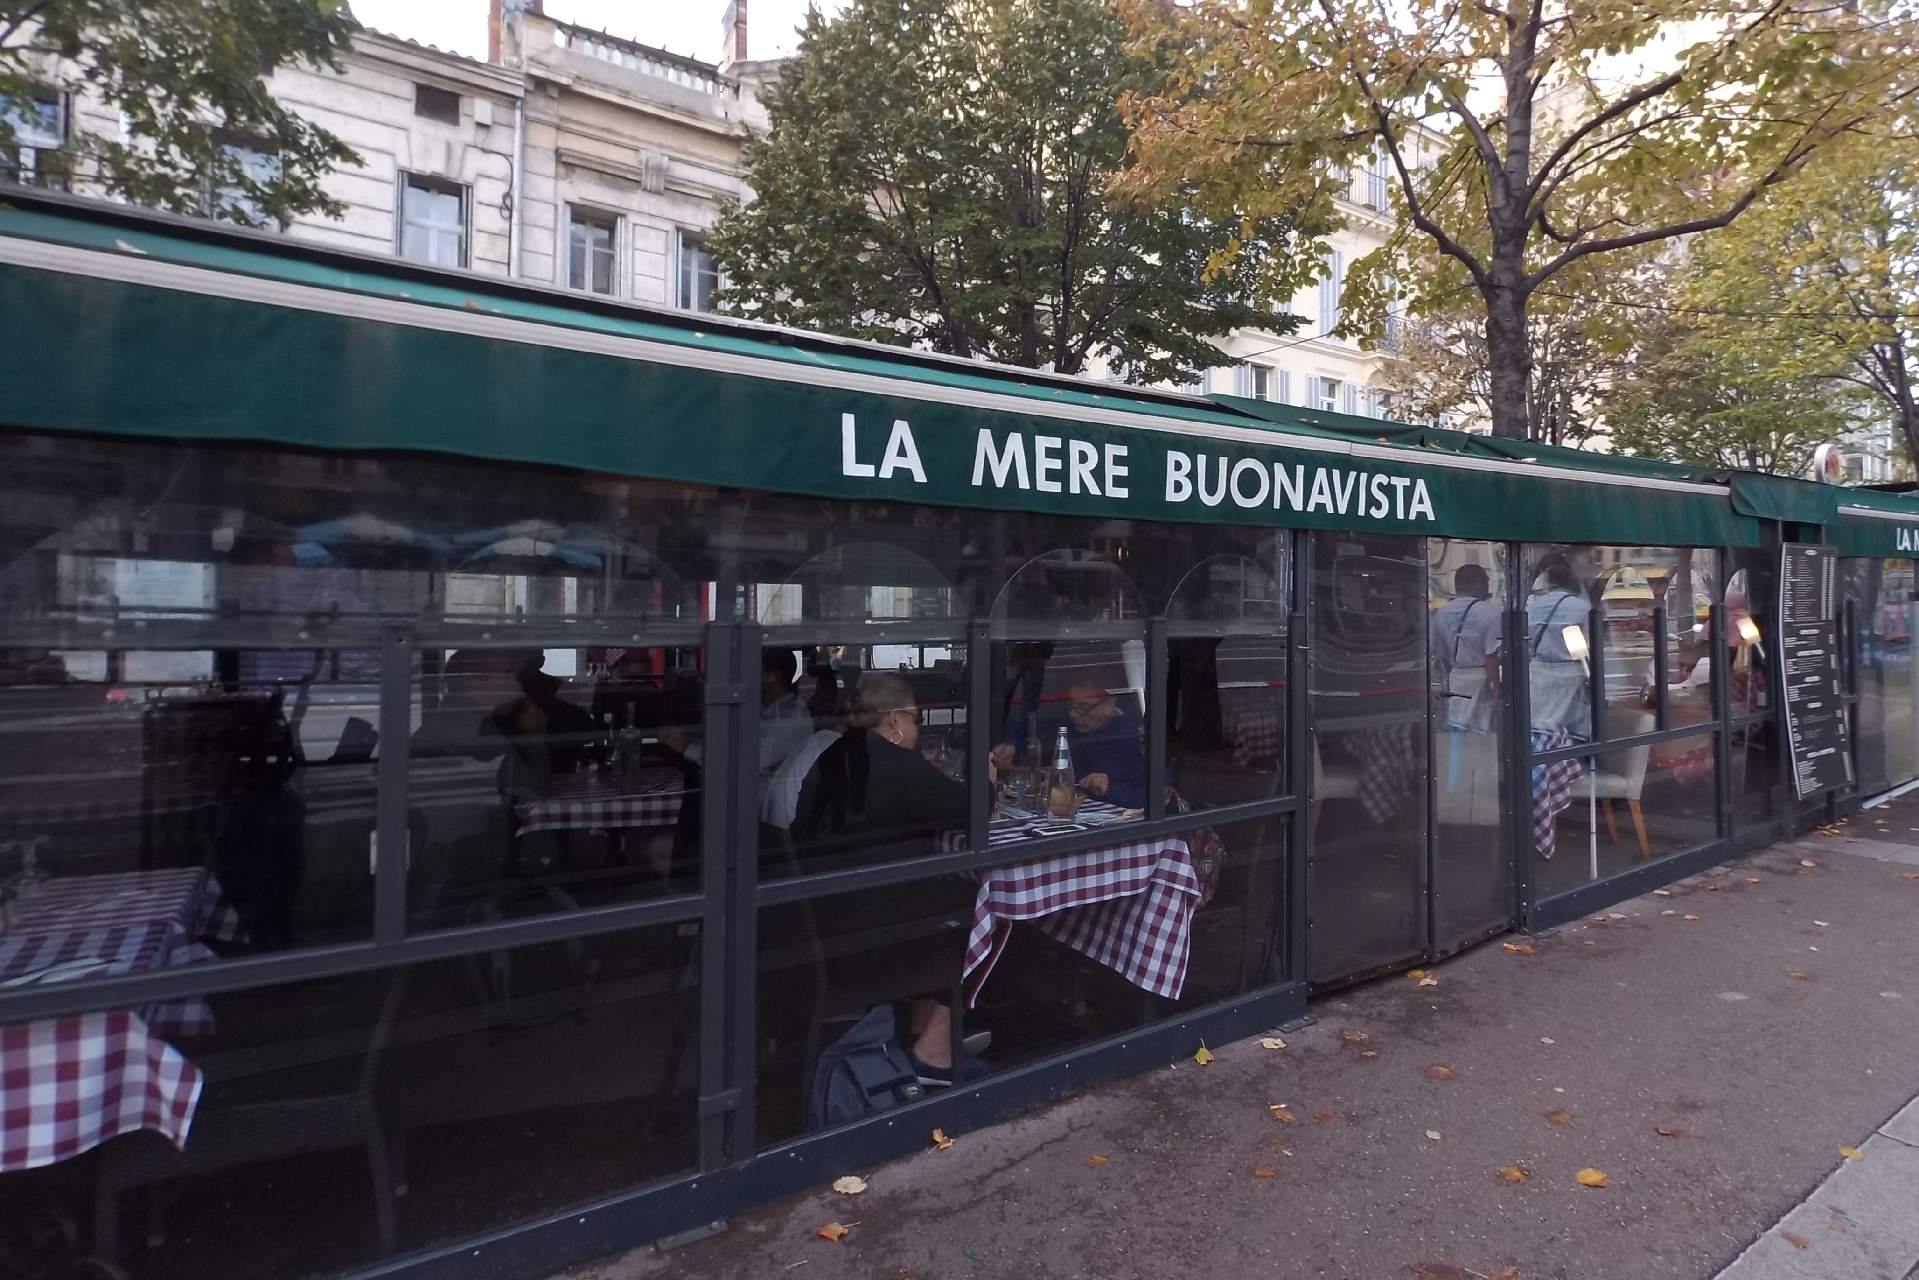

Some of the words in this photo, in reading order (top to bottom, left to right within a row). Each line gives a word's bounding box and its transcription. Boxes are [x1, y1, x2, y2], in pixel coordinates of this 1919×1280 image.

[841, 412, 928, 483] LA
[971, 428, 1129, 499] MERE
[1165, 450, 1436, 521] BUONAVISTA
[1896, 527, 1912, 551] LA
